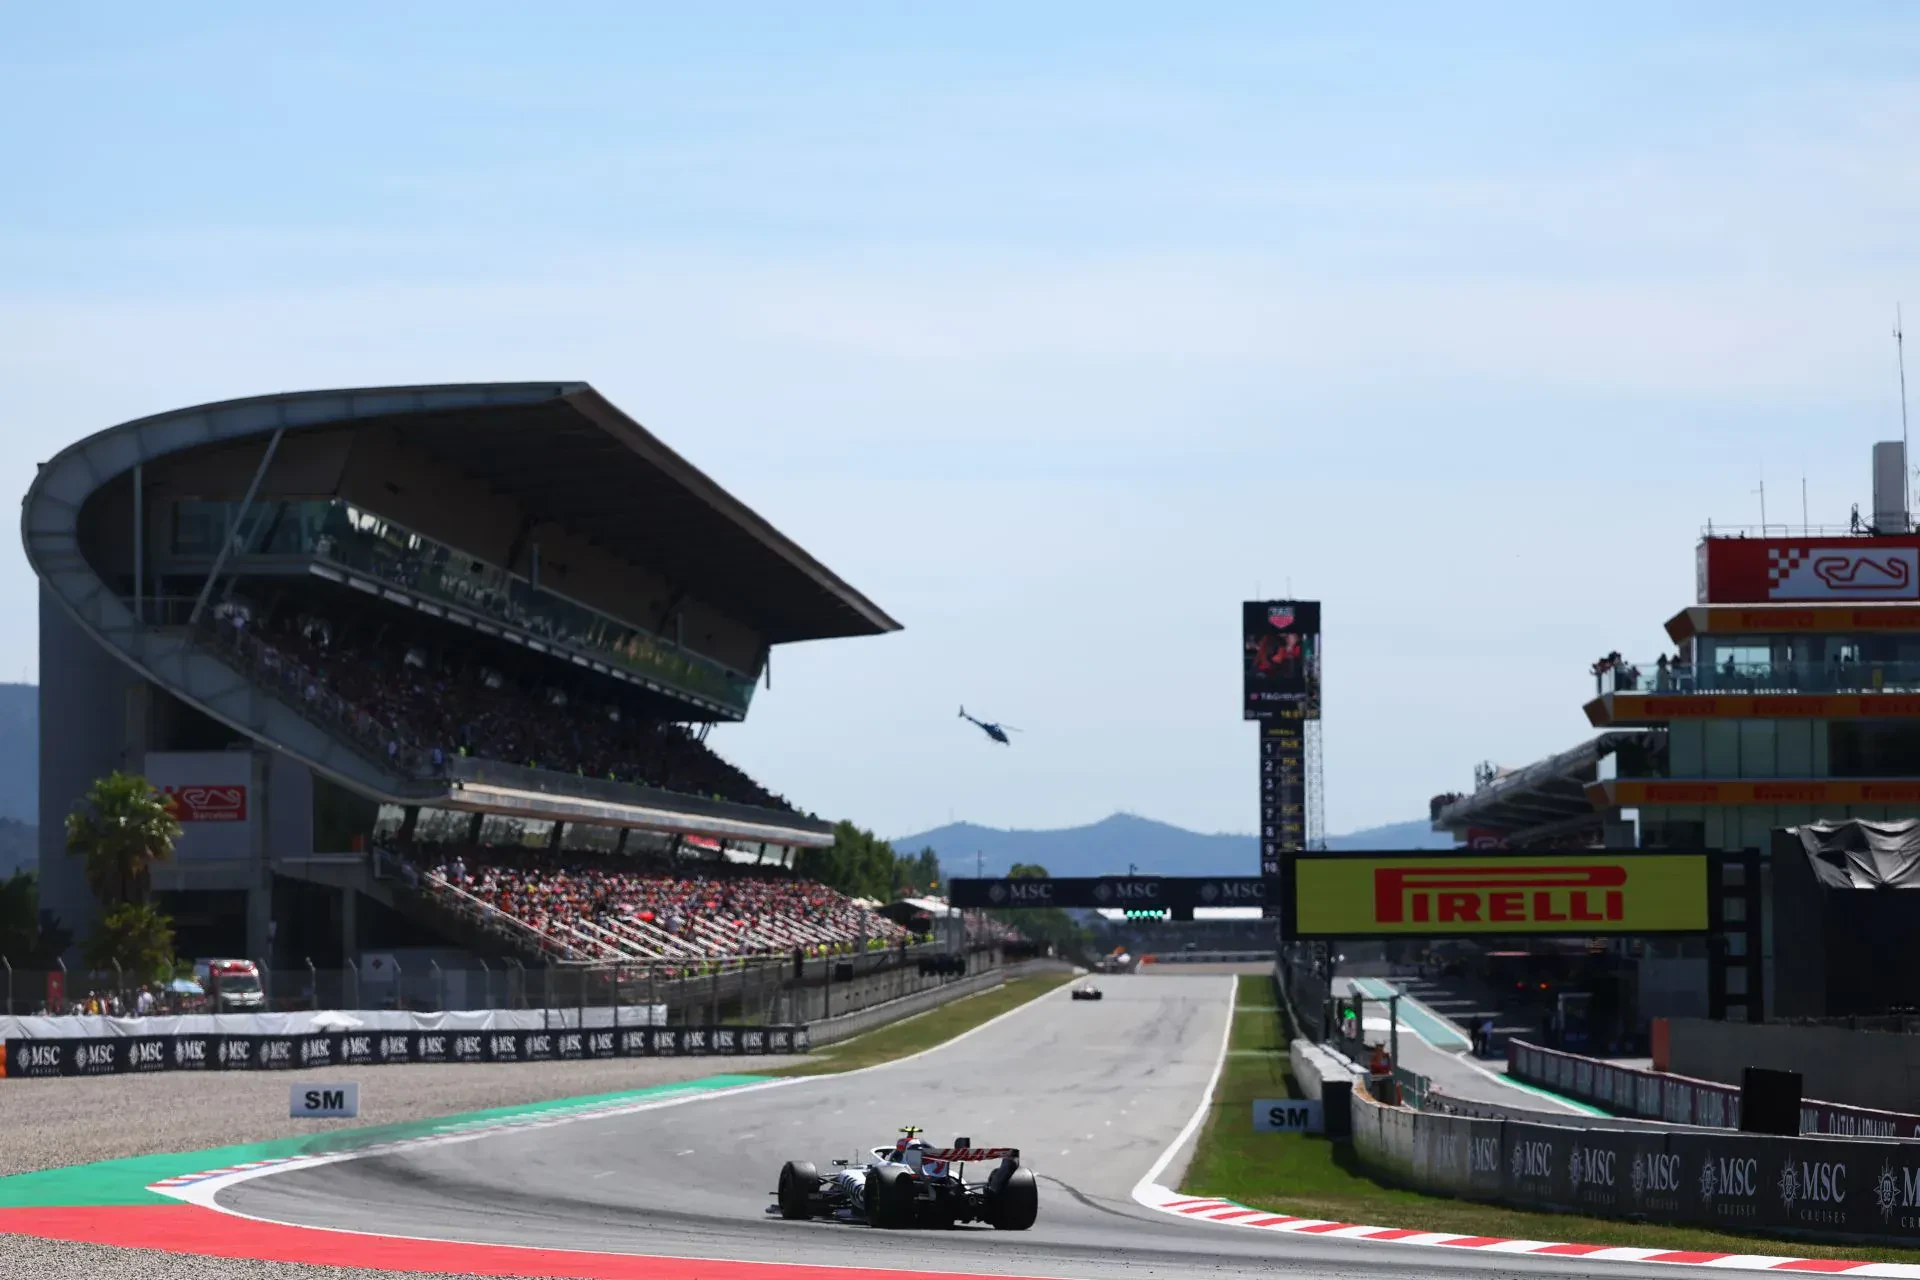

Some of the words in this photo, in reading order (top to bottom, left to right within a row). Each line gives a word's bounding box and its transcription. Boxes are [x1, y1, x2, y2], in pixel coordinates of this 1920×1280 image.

[1010, 883, 1053, 899] MSC
[1116, 883, 1159, 898] MSC
[1222, 883, 1265, 898] MSC
[1375, 866, 1627, 923] PIRELLI
[31, 1045, 61, 1066] MSC
[88, 1044, 115, 1065] MSC
[139, 1041, 164, 1062] MSC
[184, 1041, 206, 1060] MSC
[304, 1090, 344, 1110] SM
[1269, 1107, 1309, 1127] SM
[1475, 1136, 1498, 1171] MSC
[1525, 1141, 1552, 1177] MSC
[1584, 1147, 1616, 1186] MSC
[1646, 1153, 1680, 1191] MSC
[1718, 1157, 1757, 1196] MSC
[1801, 1161, 1846, 1203] MSC
[1800, 1209, 1846, 1223] CRUISES
